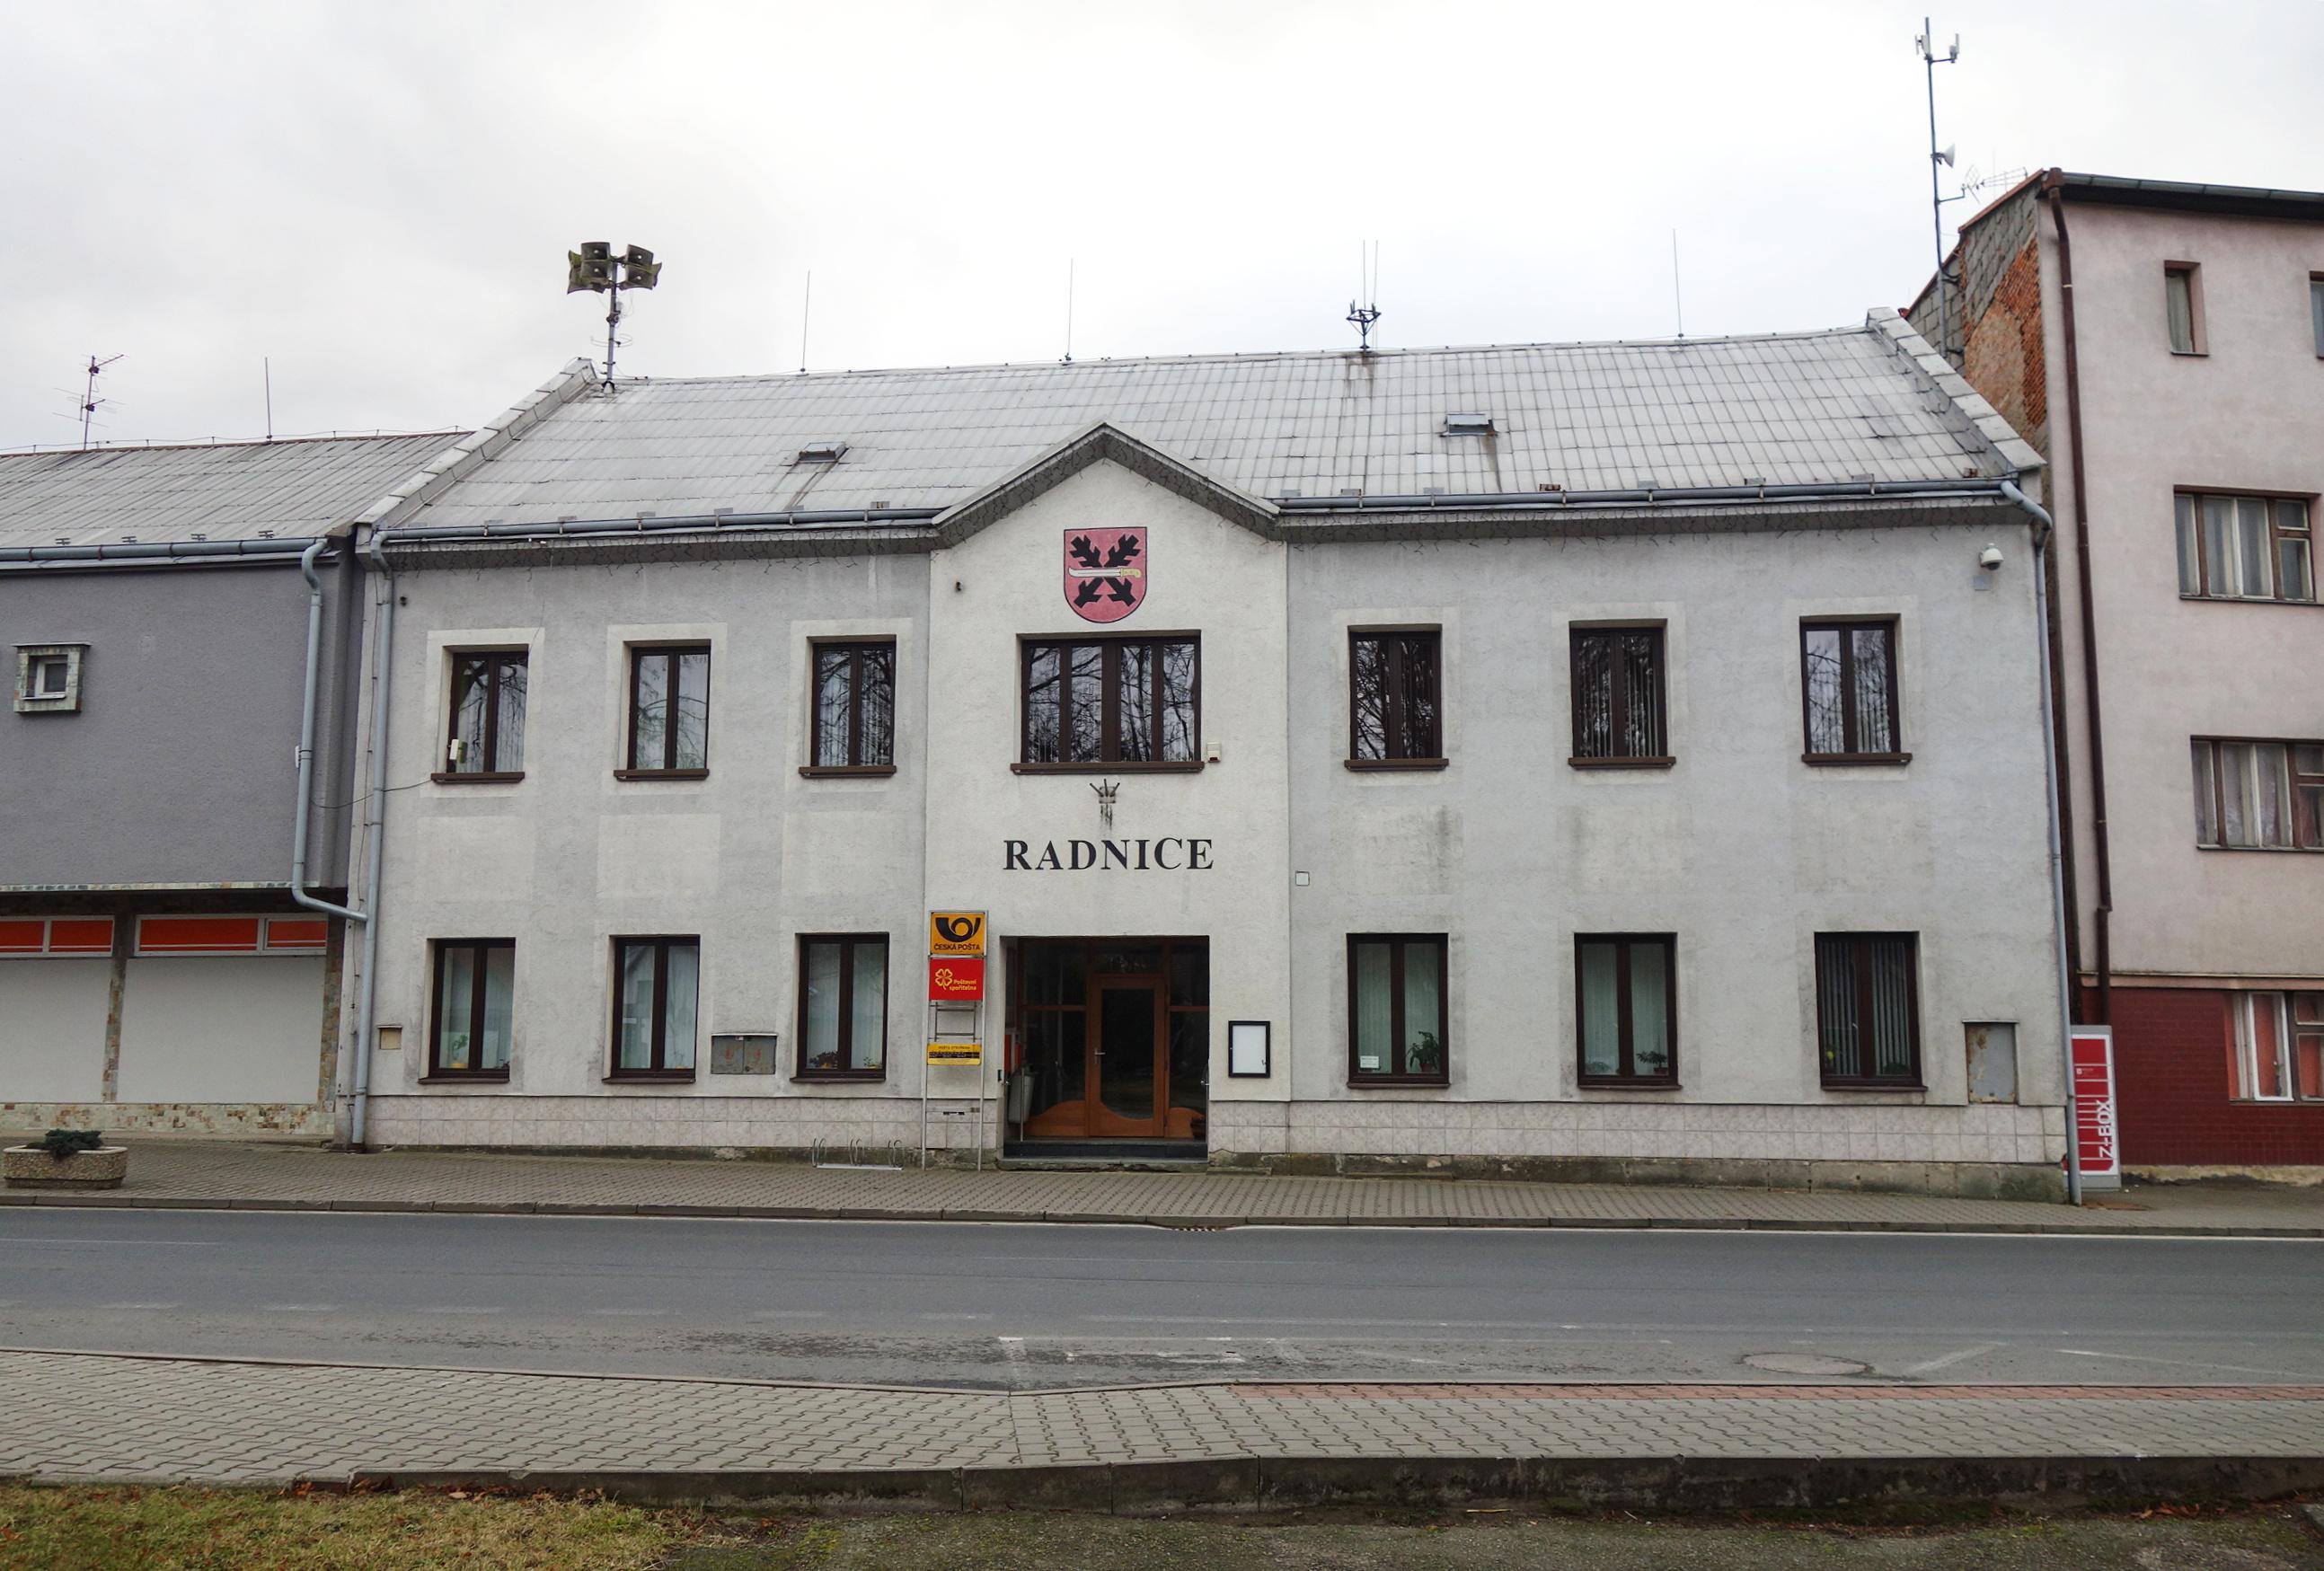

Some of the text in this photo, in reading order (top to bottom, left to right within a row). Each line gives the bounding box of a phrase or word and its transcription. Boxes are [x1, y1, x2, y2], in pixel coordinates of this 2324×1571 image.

[1003, 837, 1214, 870] RADNICE
[933, 942, 981, 950] ČESKÁ POŠTA
[2096, 1099, 2114, 1158] Z-BOX
